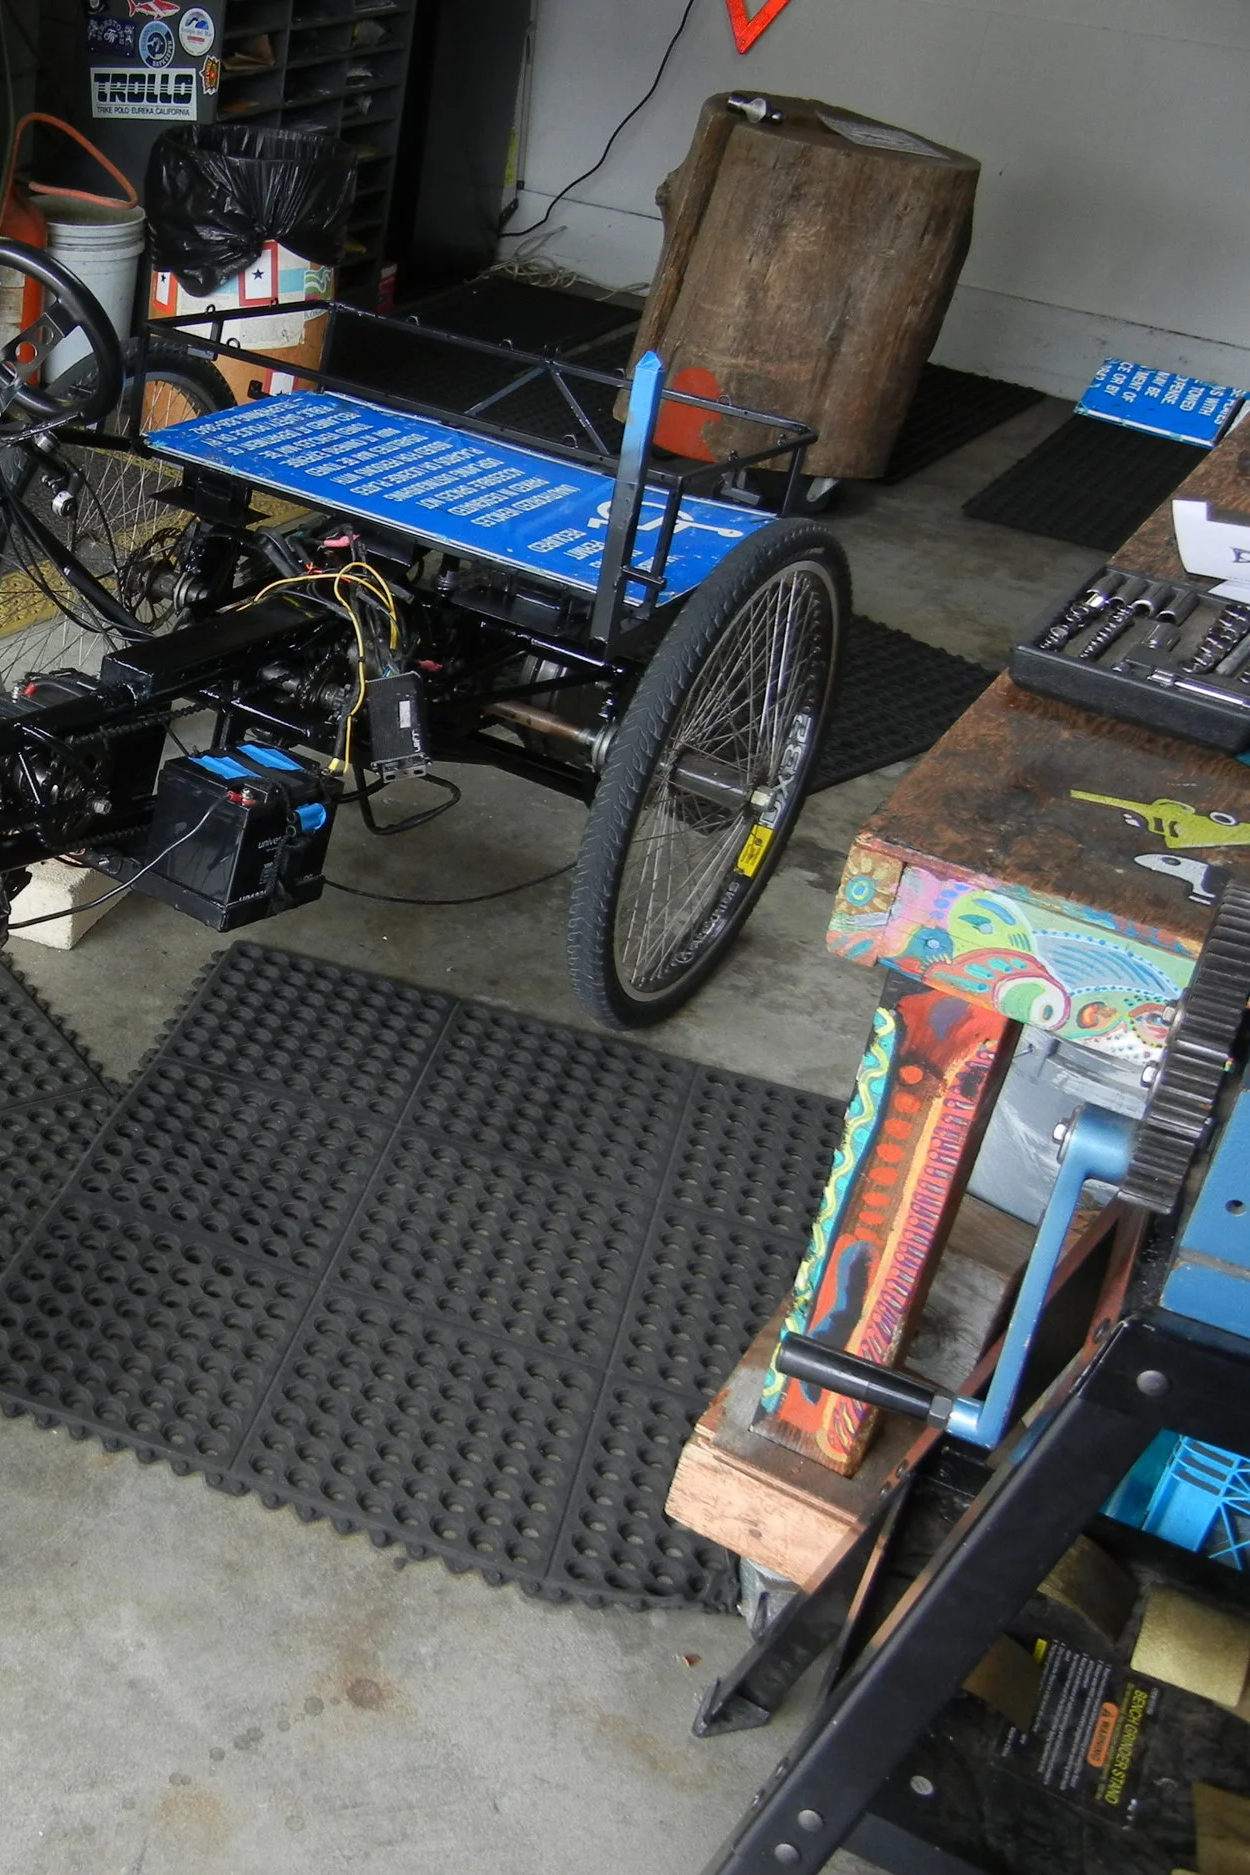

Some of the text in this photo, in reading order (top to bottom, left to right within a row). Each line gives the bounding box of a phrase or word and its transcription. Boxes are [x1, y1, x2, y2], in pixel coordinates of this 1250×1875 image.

[94, 74, 194, 104] TROLLO
[156, 108, 190, 116] CALIFORNIA
[1104, 384, 1120, 396] BY
[1110, 373, 1127, 385] OR
[1122, 392, 1137, 404] OF
[1145, 386, 1162, 398] BE
[1180, 386, 1204, 412] TOWED
[1198, 398, 1220, 416] WITH
[330, 441, 453, 485] ISSUED FOR PERSONS WITH
[336, 457, 360, 466] BE
[351, 451, 378, 461] MAY
[305, 463, 346, 476] TOWED
[350, 447, 485, 496] PLACARDS OR LICENSE PLATES
[383, 457, 504, 502] DISPLAYING DISTINGUISHING
[416, 468, 525, 509] ACCESSIBLE SPACES NOT
[448, 477, 550, 516] PARKED IN DESIGNATED
[471, 484, 580, 527] UNAUTHORIZED VEHICLES
[527, 528, 587, 552] REQUIRED
[564, 540, 605, 560] PERMIT
[1105, 1689, 1148, 1804] BENCH GRINDER STAND
